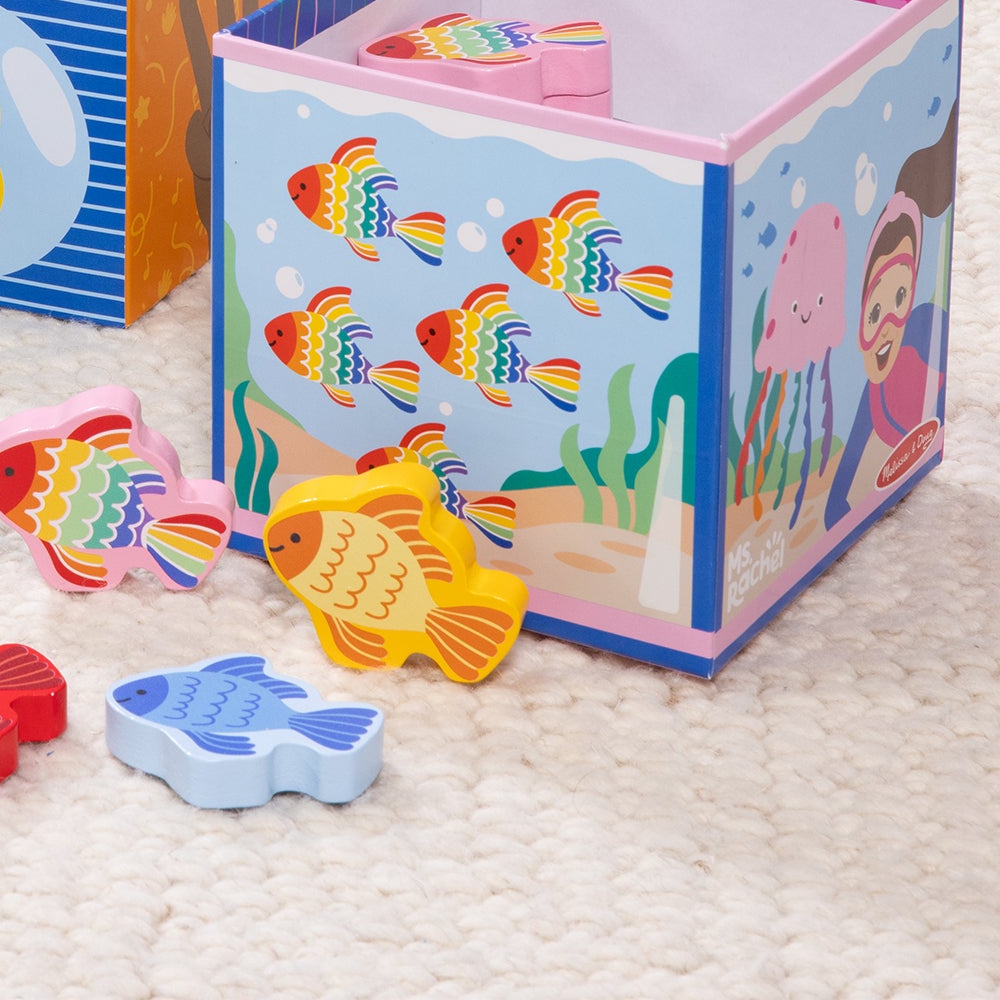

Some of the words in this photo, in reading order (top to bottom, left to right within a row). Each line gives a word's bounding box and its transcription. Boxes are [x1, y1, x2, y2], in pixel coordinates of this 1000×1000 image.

[881, 452, 911, 482] Melissa
[916, 429, 934, 450] Doug
[727, 538, 785, 613] Rachel
